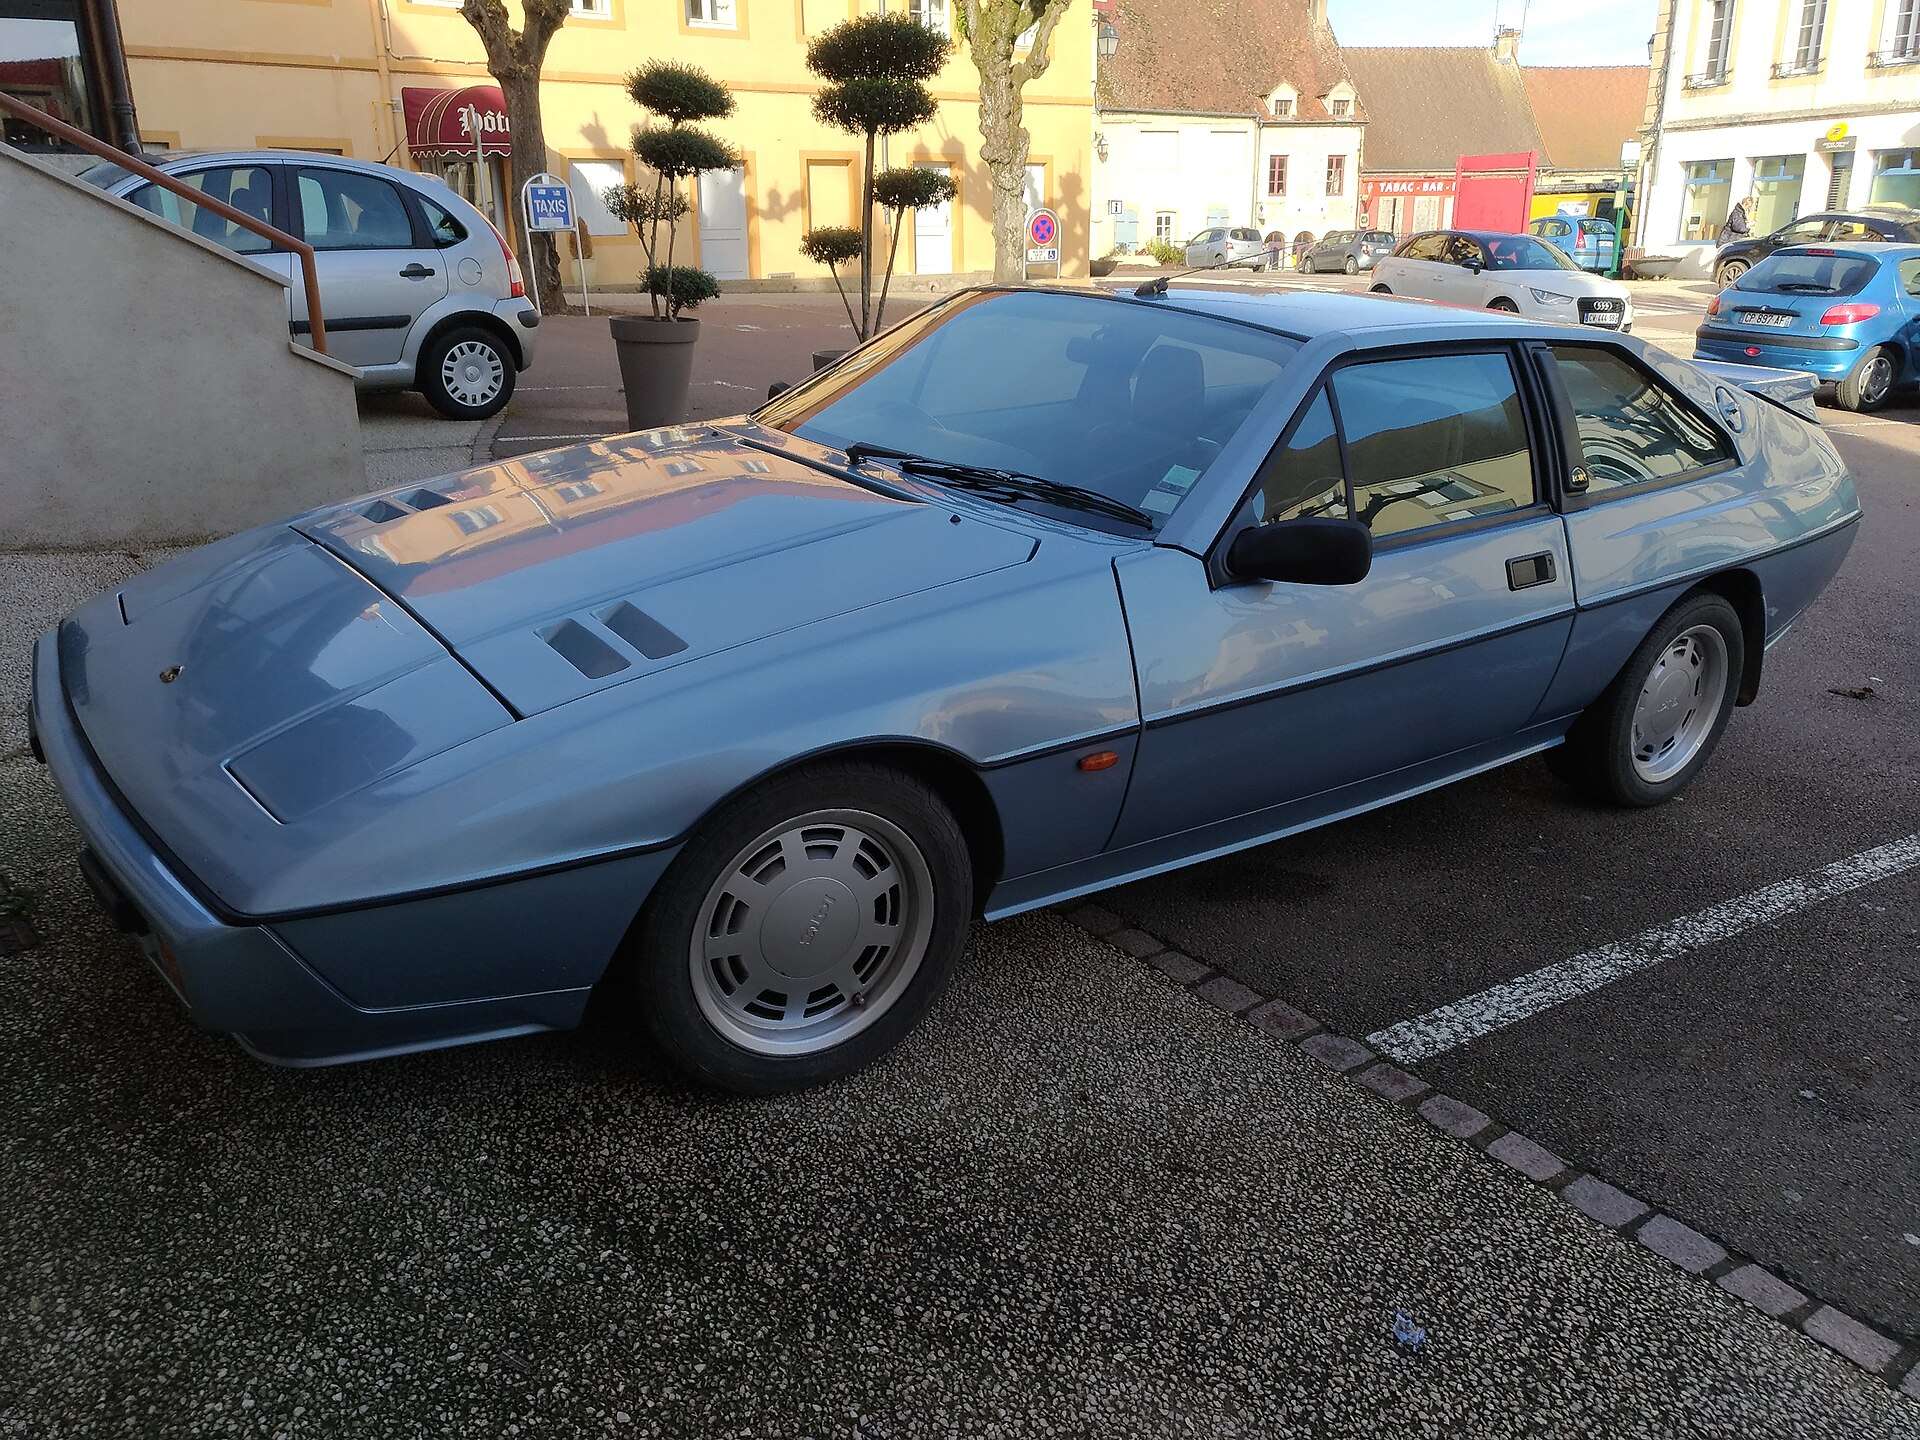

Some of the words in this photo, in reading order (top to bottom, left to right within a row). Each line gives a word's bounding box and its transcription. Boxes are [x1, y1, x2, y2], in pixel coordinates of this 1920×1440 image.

[1379, 182, 1414, 193] TABAC
[1422, 182, 1443, 193] BAR
[533, 199, 567, 213] TAXIS
